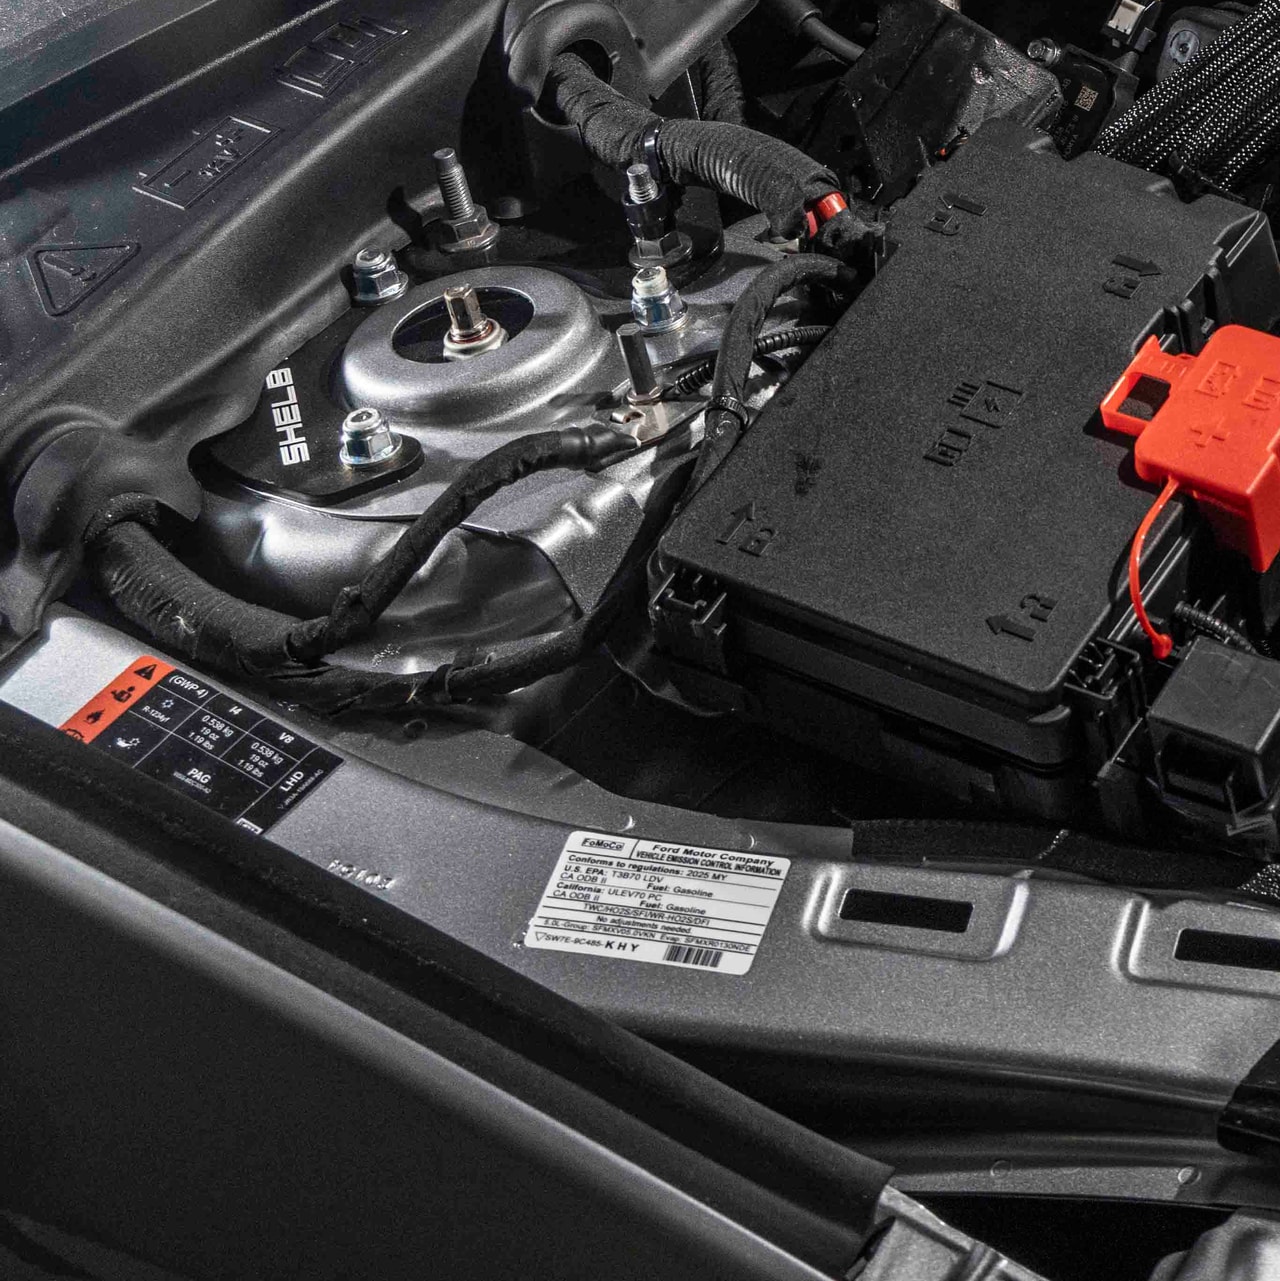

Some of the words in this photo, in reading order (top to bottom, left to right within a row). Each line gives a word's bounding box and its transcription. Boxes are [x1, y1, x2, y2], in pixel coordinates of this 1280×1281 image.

[265, 367, 311, 466] SHELB
[200, 726, 210, 736] 19
[210, 732, 220, 741] oz
[201, 714, 223, 732] 0.538
[222, 726, 235, 738] kg
[188, 731, 203, 746] 1.19
[202, 740, 215, 751] lbs
[278, 731, 295, 744] V8
[250, 741, 274, 759] 0.538
[272, 752, 284, 766] kg
[250, 753, 259, 764] 19
[258, 759, 269, 769] oz
[186, 767, 212, 784] PAG
[237, 758, 253, 773] 1.19
[251, 767, 265, 778] lbs
[279, 770, 305, 793] LHD
[582, 838, 624, 851] FoMoCo
[636, 850, 665, 861] VEHICLE
[666, 854, 699, 866] EMISSION
[700, 858, 732, 870] CONTROL
[734, 863, 782, 876] INFORMATION
[652, 844, 680, 854] Ford
[682, 848, 716, 859] Motor
[719, 853, 775, 867] Company
[560, 872, 574, 880] CA
[564, 864, 582, 873] U.S.
[585, 868, 609, 876] EPA:
[611, 870, 641, 880] T3B70
[643, 875, 664, 883] LDV
[568, 854, 614, 867] Conforms
[616, 860, 626, 868] to
[628, 862, 684, 876] regulations:
[686, 869, 709, 879] 2025
[711, 872, 728, 881] MY
[553, 889, 567, 897] CA
[556, 881, 606, 894] California:
[608, 888, 646, 899] ULEV70
[647, 893, 663, 901] PC
[646, 883, 670, 892] Fuel:
[673, 886, 714, 898] Gasoline
[639, 900, 664, 909] Fuel:
[666, 903, 707, 915] Gasoline
[596, 915, 608, 923] No
[610, 918, 659, 930] adjustments
